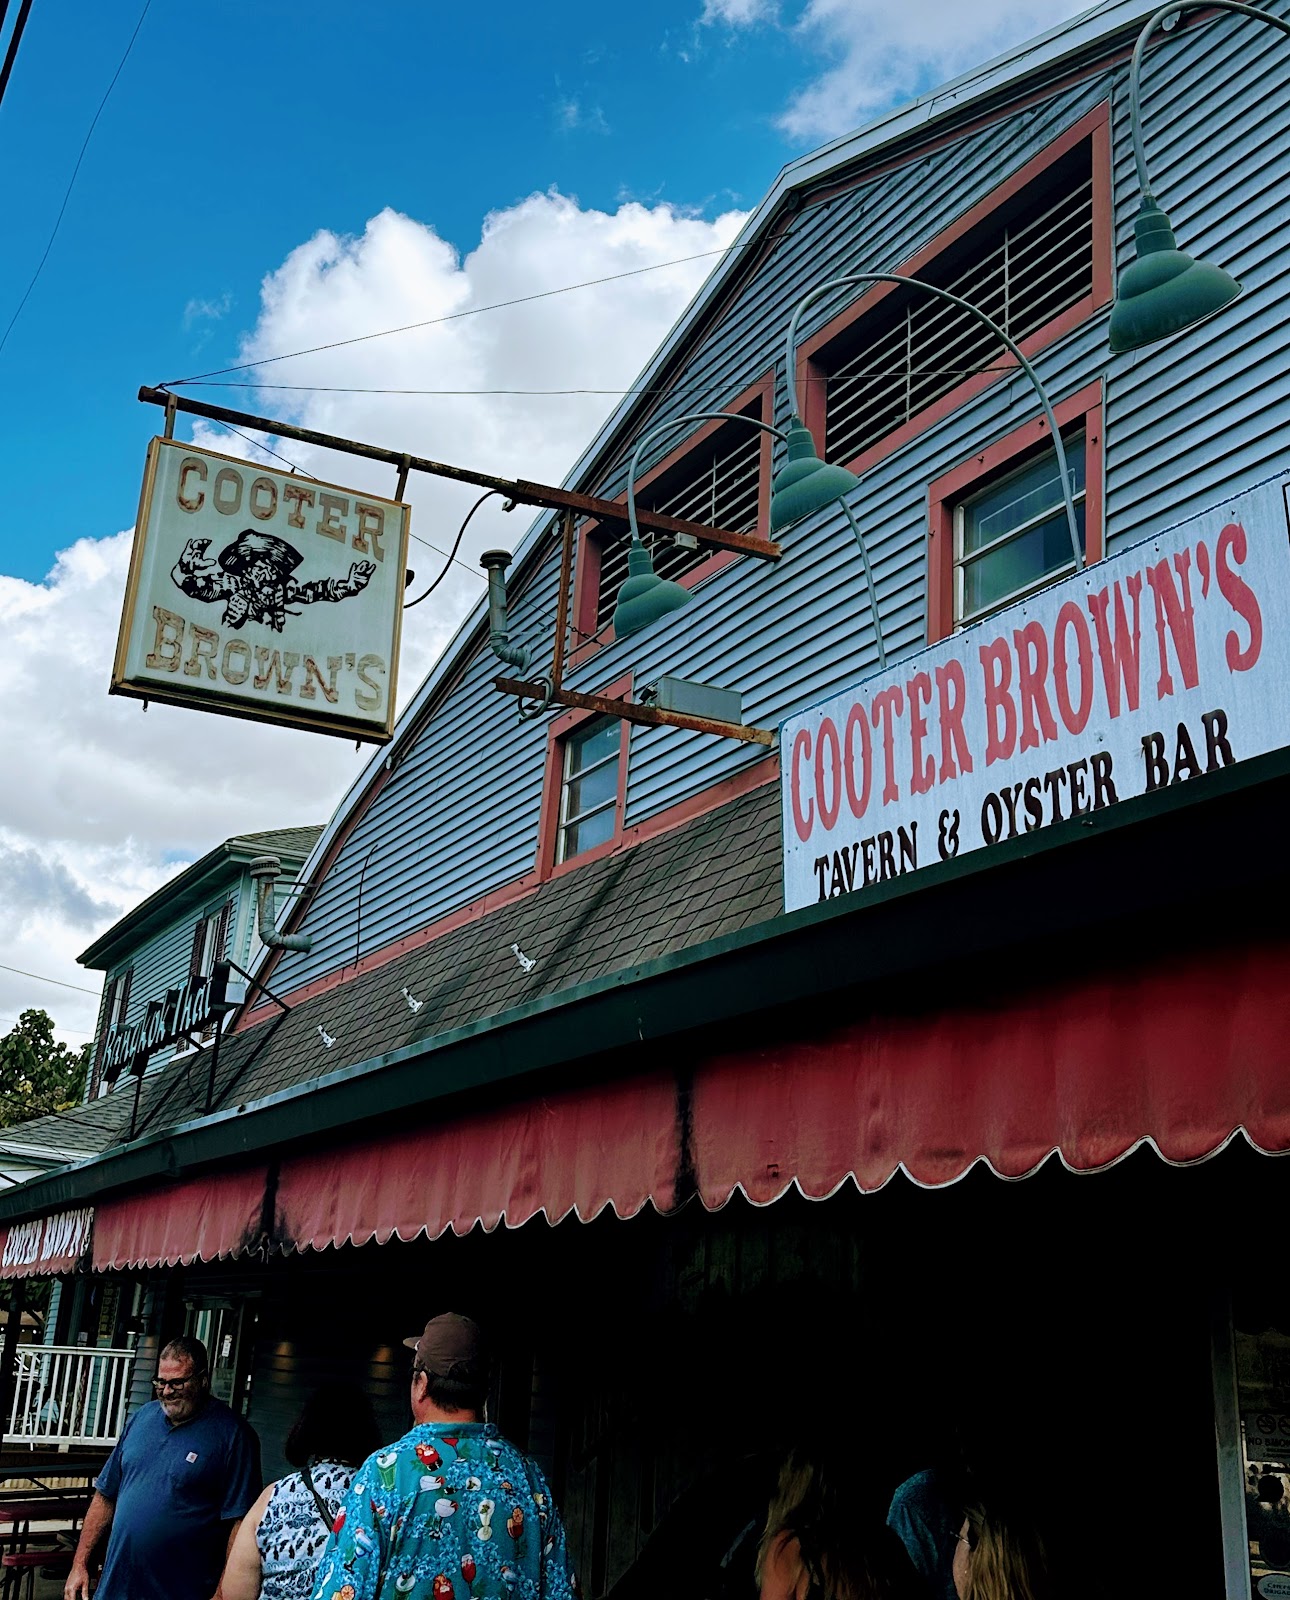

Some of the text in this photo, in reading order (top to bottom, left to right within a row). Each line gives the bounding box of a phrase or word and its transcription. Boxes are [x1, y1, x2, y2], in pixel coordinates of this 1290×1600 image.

[177, 457, 386, 563] COOTER
[145, 605, 386, 711] BROWN'S
[791, 522, 1263, 842] COOTER BROWN'S
[814, 708, 1236, 902] TAVERN & OYSTER BAR
